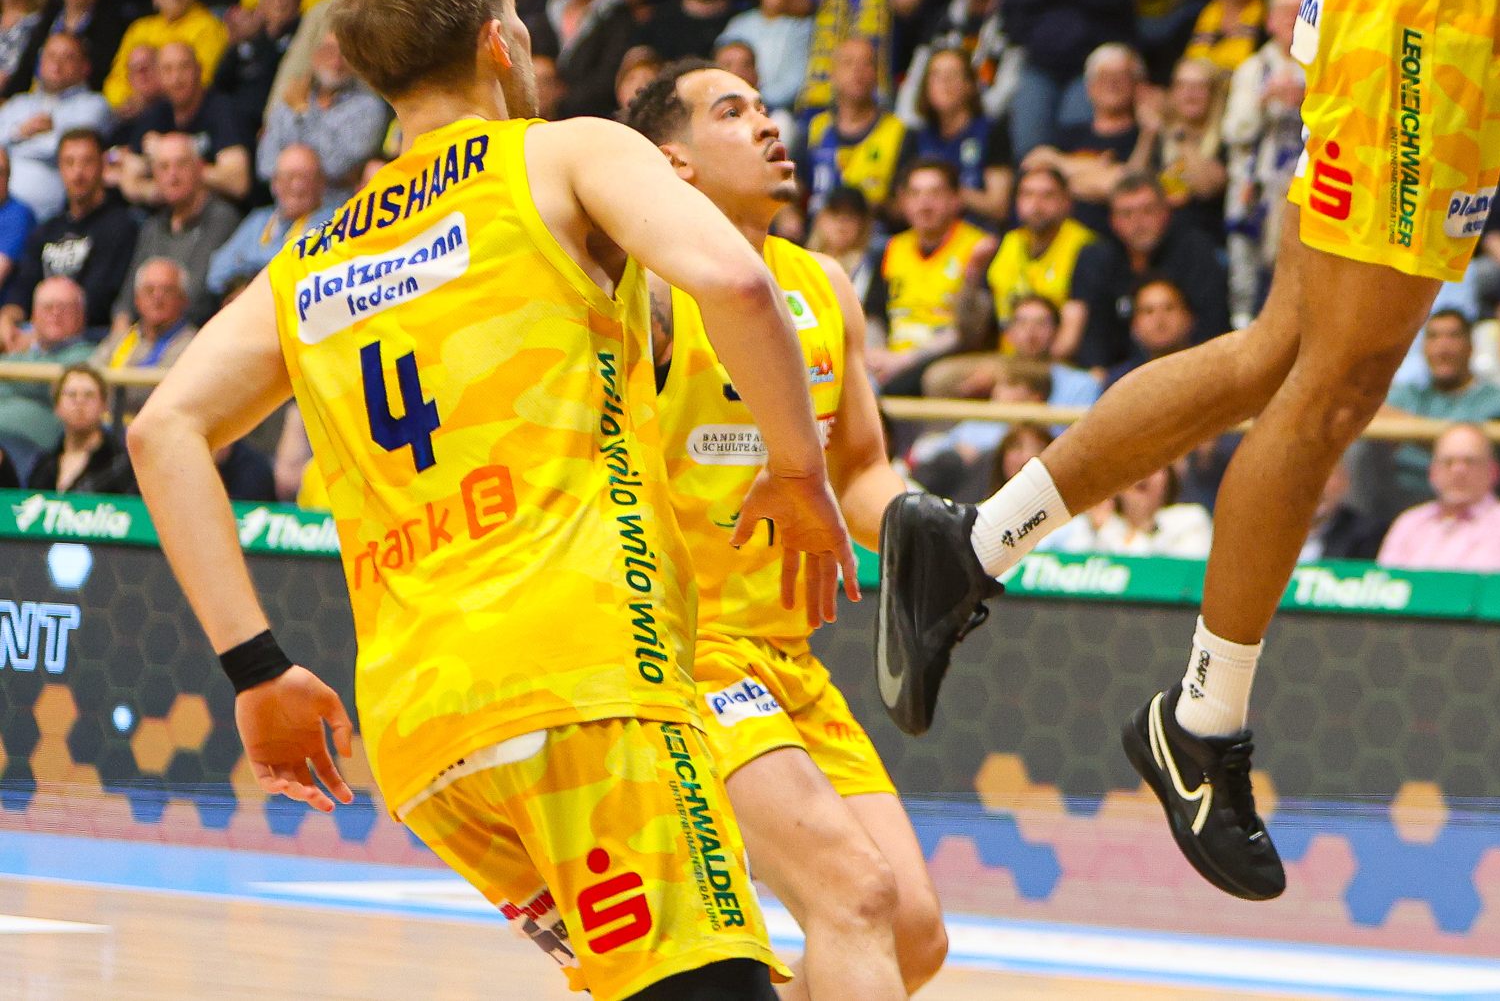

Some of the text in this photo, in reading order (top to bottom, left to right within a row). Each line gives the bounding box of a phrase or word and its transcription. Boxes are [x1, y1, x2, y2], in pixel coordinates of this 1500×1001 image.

[360, 340, 441, 474] 4
[597, 352, 624, 436] wilo
[703, 432, 764, 442] BANDSTA
[42, 500, 131, 539] Thalia
[1016, 509, 1047, 540] CRAFT
[616, 515, 657, 593] wilo
[1018, 552, 1131, 595] Thalia
[1294, 567, 1413, 610] Thalia
[628, 603, 668, 685] wilo
[1195, 650, 1211, 687] CRAFT
